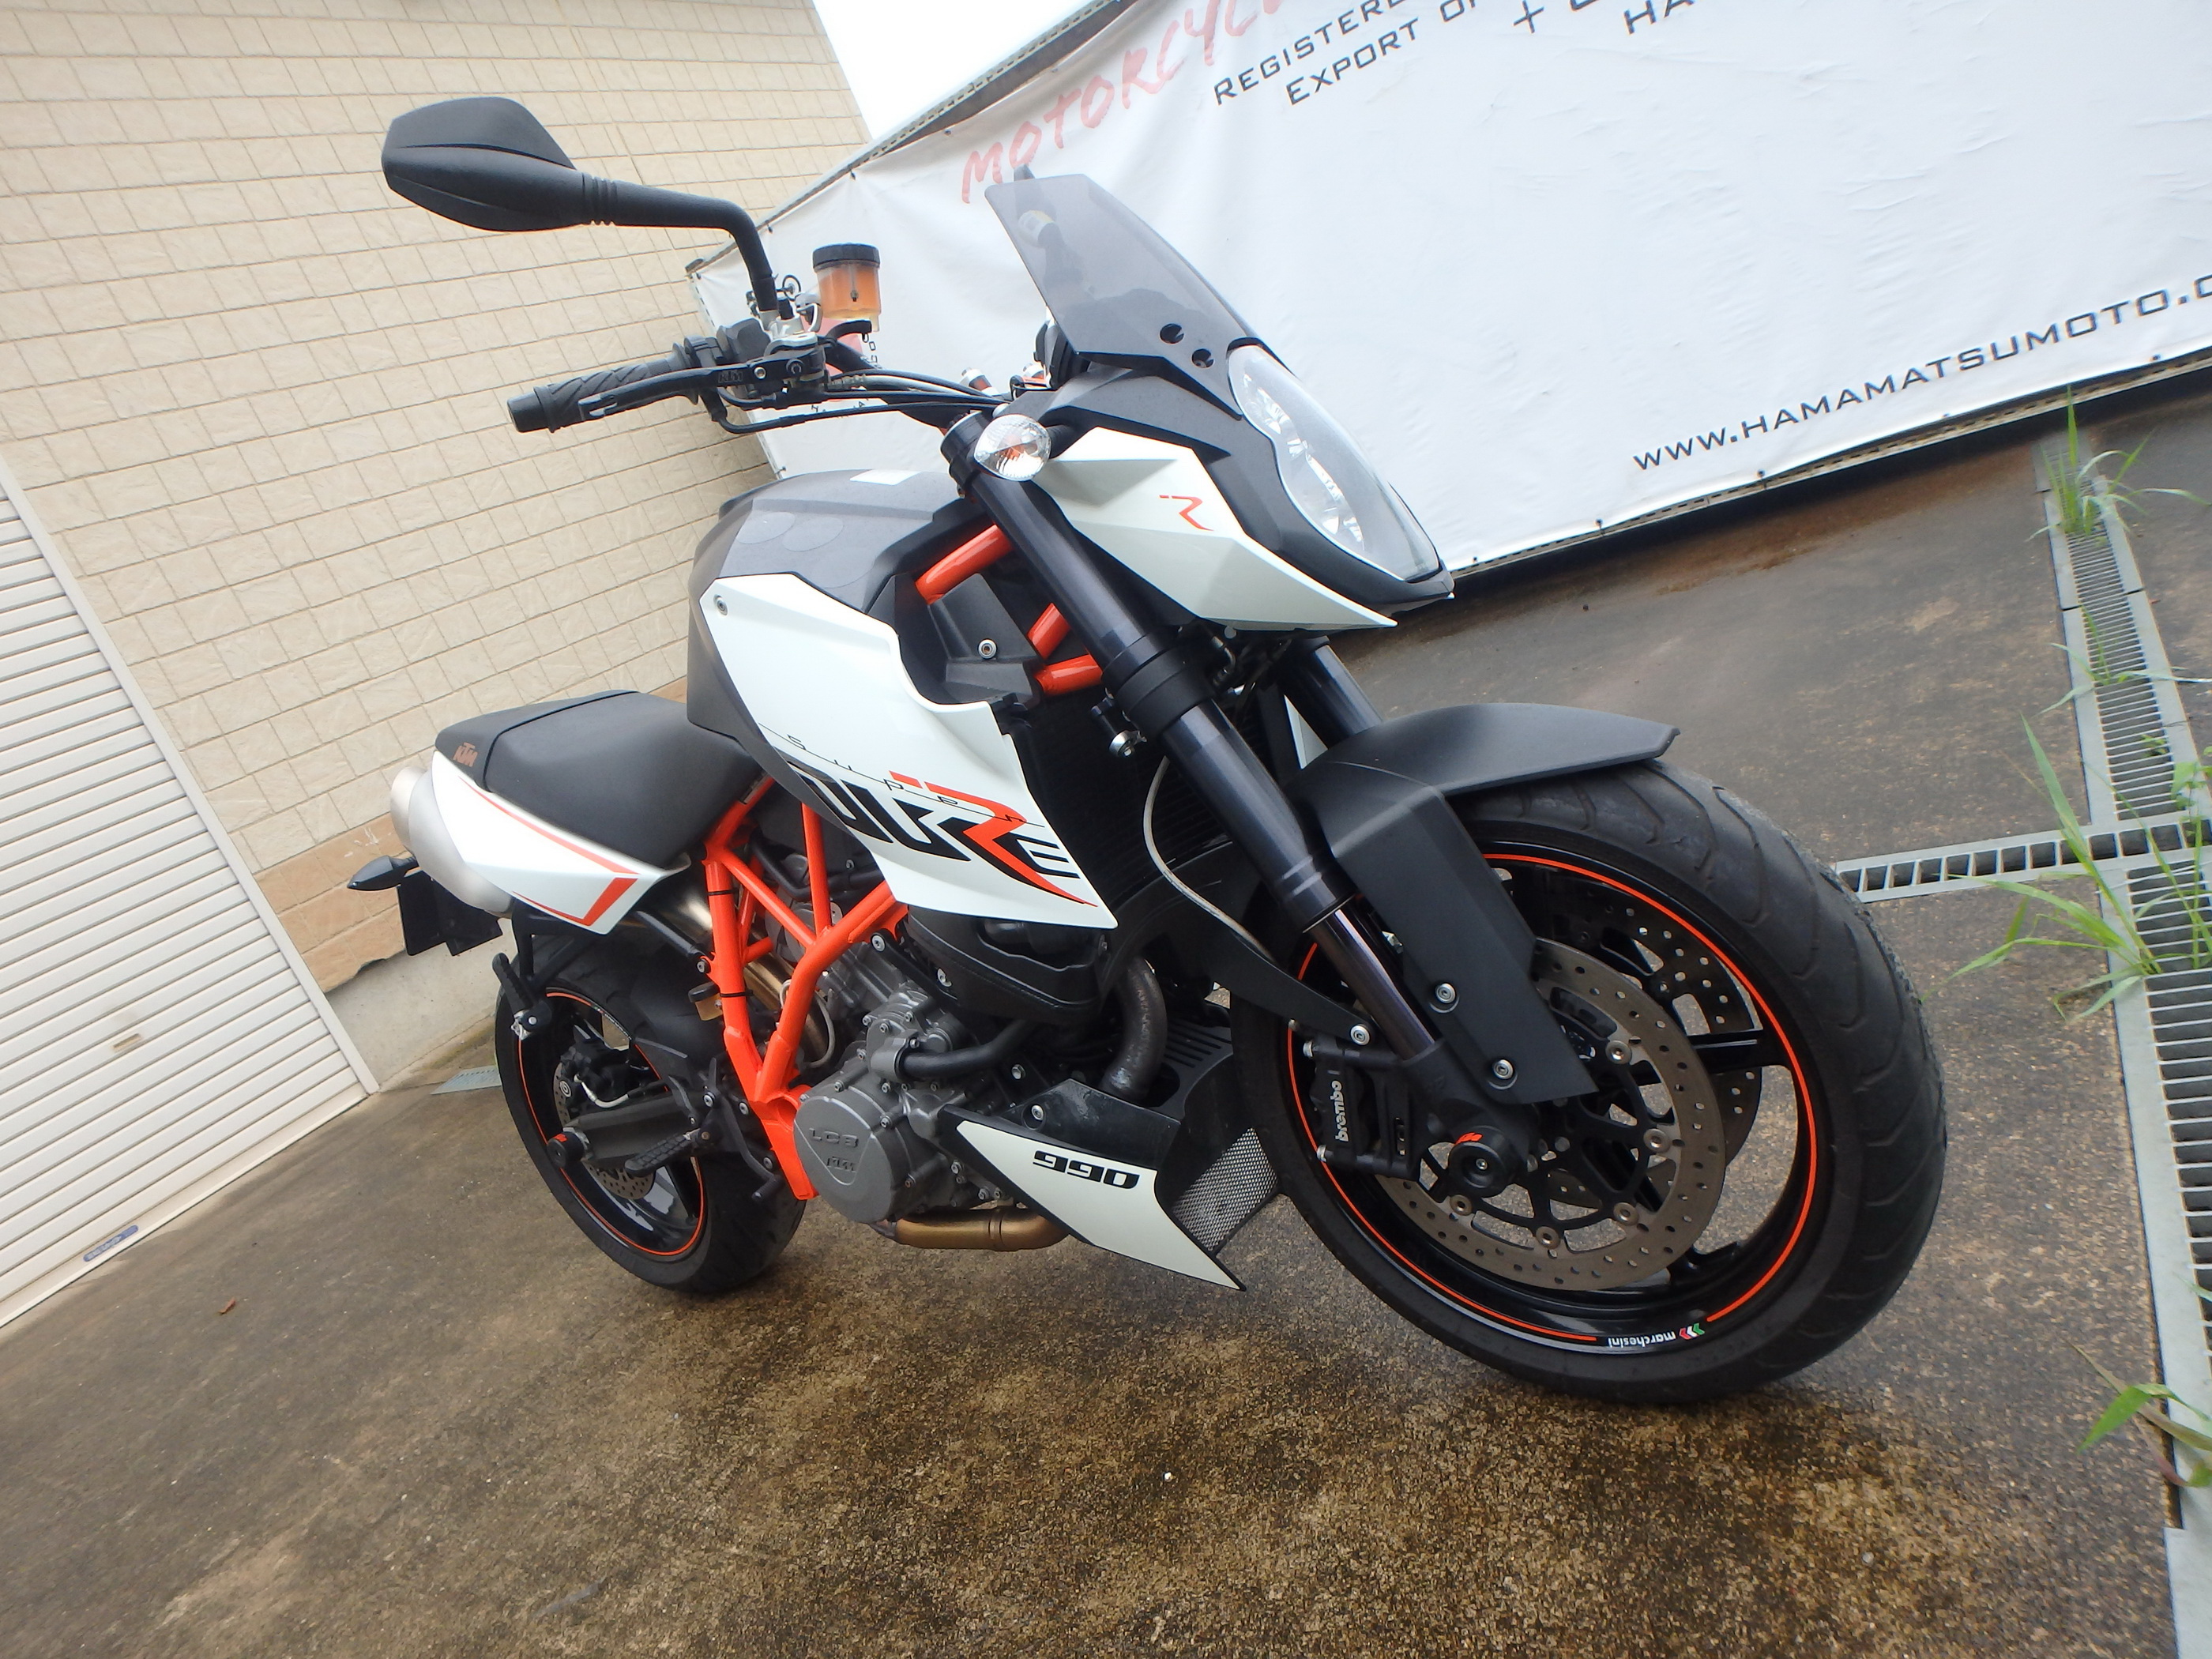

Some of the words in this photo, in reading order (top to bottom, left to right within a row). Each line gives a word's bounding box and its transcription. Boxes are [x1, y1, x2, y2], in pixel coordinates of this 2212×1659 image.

[1285, 17, 1419, 105] EXPORT
[961, 0, 1281, 204] MOTORCYC
[1330, 1080, 1349, 1142] brembo
[1033, 1150, 1140, 1189] 990
[1608, 1330, 1676, 1348] marchesini
